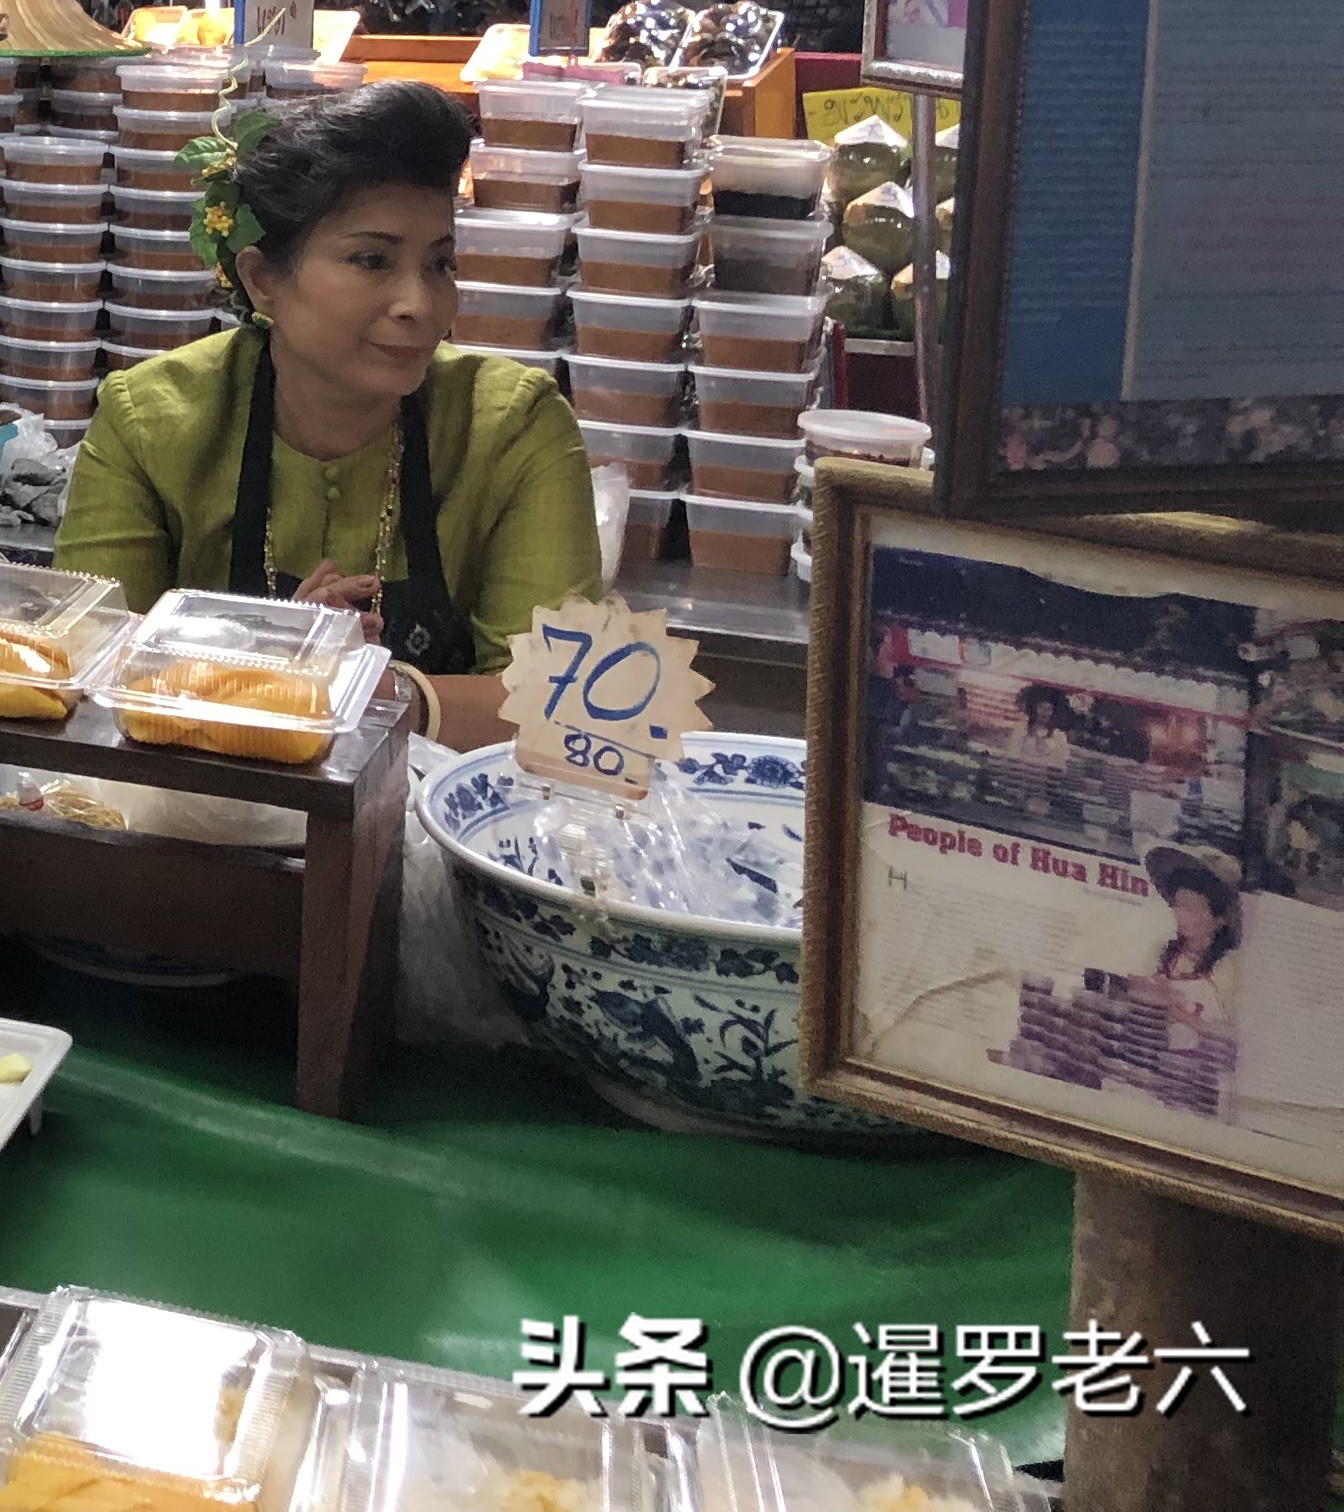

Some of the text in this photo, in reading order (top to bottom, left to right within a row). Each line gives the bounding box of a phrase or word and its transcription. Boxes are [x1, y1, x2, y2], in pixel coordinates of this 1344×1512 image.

[887, 813, 983, 856] People
[992, 841, 1021, 866] of
[1029, 846, 1088, 884] Hua
[1097, 862, 1150, 898] Hin
